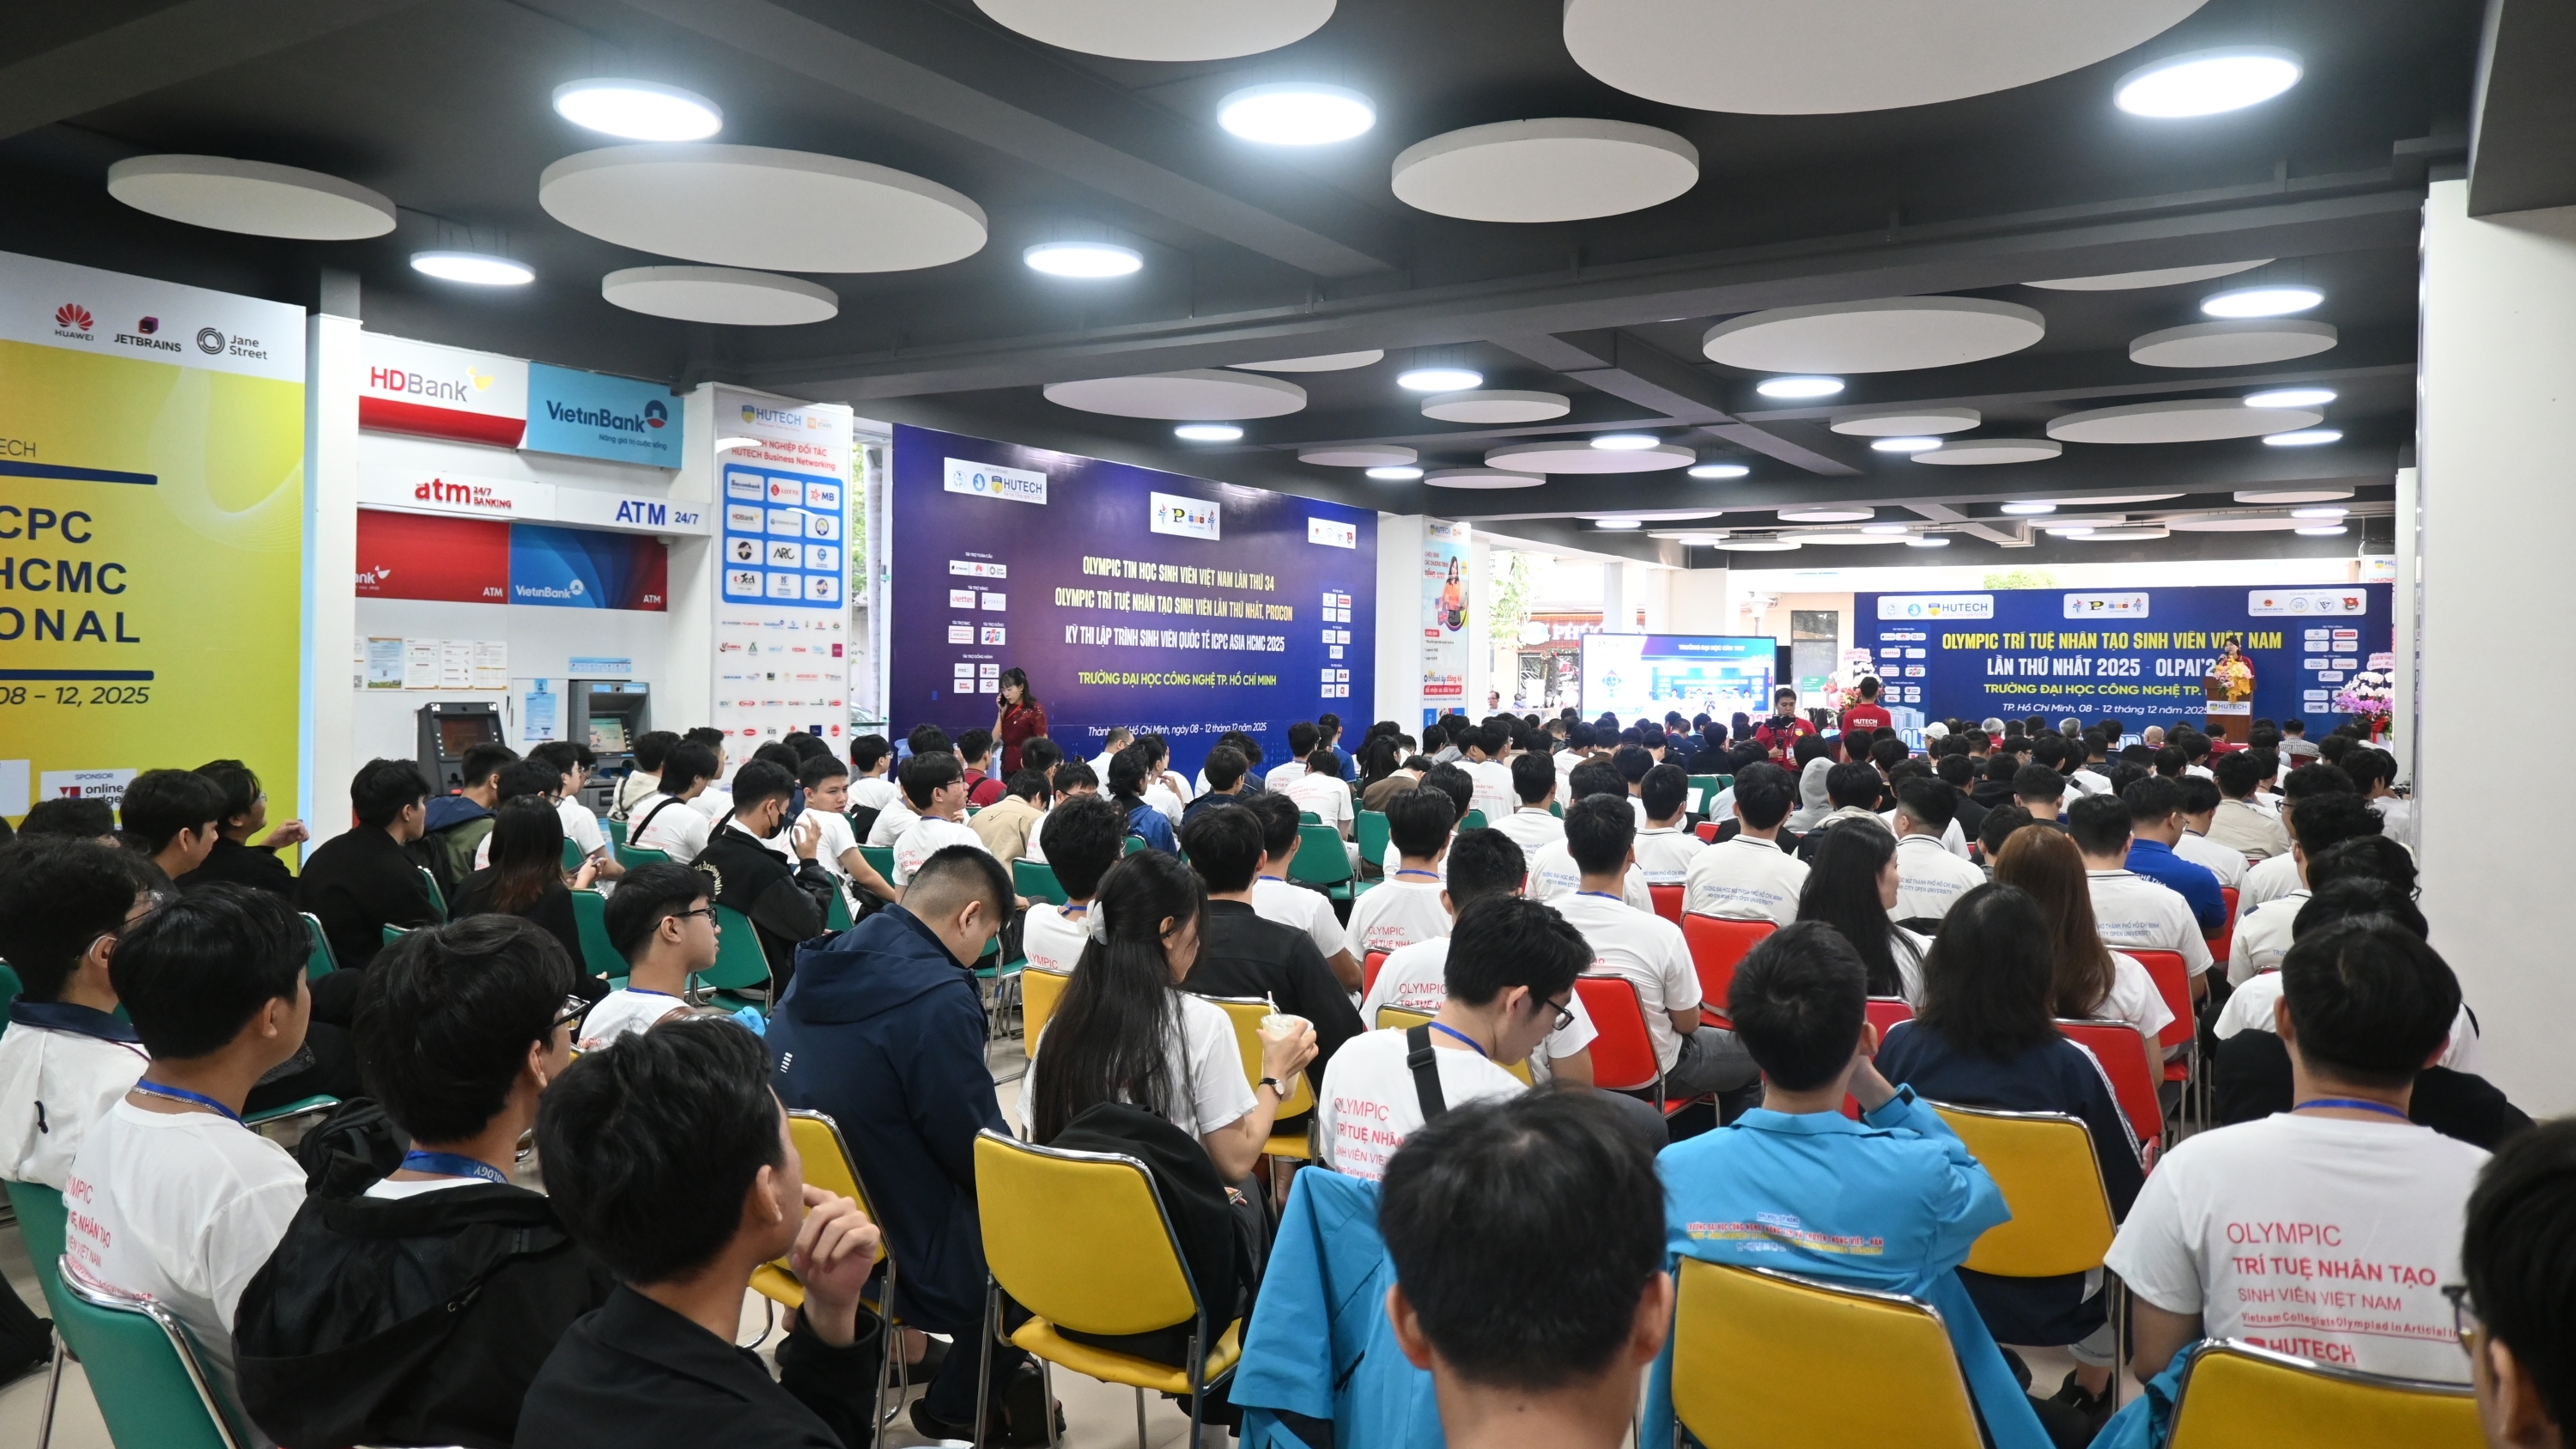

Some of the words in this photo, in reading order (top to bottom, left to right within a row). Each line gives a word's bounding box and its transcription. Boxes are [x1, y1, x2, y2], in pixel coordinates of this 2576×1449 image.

[55, 330, 94, 341] HUAWEI
[114, 333, 181, 352] JETBRAINS
[230, 335, 259, 347] Jane
[229, 346, 268, 360] Street
[371, 367, 467, 402] HDBank
[756, 408, 801, 425] HUTECH
[769, 441, 795, 454] NGHIỆP
[799, 445, 811, 454] ĐỐI
[814, 447, 827, 457] TÁC
[732, 448, 762, 459] HUTECH
[764, 452, 794, 464] Business
[797, 457, 835, 471] Networking
[415, 478, 471, 505] atm
[473, 486, 491, 496] 24/7
[1004, 478, 1042, 494] HUTECH
[473, 496, 512, 508] BANKING
[822, 491, 834, 501] MB
[616, 501, 665, 526] ATM
[675, 512, 699, 524] 24/7
[1435, 526, 1450, 534] HUTECH
[1083, 556, 1121, 577] OLYMPIC
[1123, 560, 1137, 579] TIN
[1139, 562, 1157, 582] HỌC
[1159, 564, 1178, 582] SINH
[1180, 565, 1197, 584] VIÊN
[1200, 568, 1215, 588] VIỆT
[1218, 570, 1233, 588] NAM
[1235, 569, 1247, 589] LẦN
[1249, 573, 1263, 591] THỨ
[1265, 575, 1274, 591] 34
[483, 588, 503, 597] ATM
[643, 594, 661, 604] ATM
[1055, 588, 1095, 608] OLYMPIC
[1097, 589, 1112, 609] TRÍ
[1114, 591, 1130, 612] TUỆ
[1133, 593, 1155, 612] NHÂN
[1157, 595, 1172, 615] TẠO
[1175, 597, 1194, 615] SINH
[1195, 598, 1212, 616] VIÊN
[1214, 597, 1227, 617] LẦN
[1266, 605, 1292, 621] PROCON
[1942, 603, 1988, 612] HUTECH
[1066, 624, 1078, 643] KỲ
[1080, 626, 1094, 644] THI
[1096, 625, 1112, 647] LẬP
[1114, 626, 1138, 646] TRÌNH
[1140, 629, 1158, 647] SINH
[1161, 629, 1177, 648] VIÊN
[1179, 629, 1200, 649] QUỐC
[1201, 630, 1210, 649] TẾ
[1212, 633, 1228, 650] ICPC
[1230, 634, 1245, 650] ASIA
[1247, 635, 1266, 651] HCMC
[1267, 636, 1285, 652] 2025
[1942, 633, 1999, 649] OLYMPIC
[2003, 631, 2026, 648] TRÍ
[2029, 631, 2055, 651] TUỆ
[2059, 631, 2097, 648] NHÂN
[2102, 632, 2129, 651] TẠO
[2133, 632, 2168, 649] SINH
[2173, 630, 2206, 648] VIÊN
[2210, 630, 2243, 648] VIT
[2249, 632, 2282, 648] NAM
[1987, 654, 2014, 675] LẦN
[2019, 656, 2049, 676] THỨ
[2053, 654, 2092, 676] NHẤT
[2097, 658, 2141, 677] 2025
[2155, 658, 2216, 677] OLPAI'2
[1078, 669, 1120, 685] TRƯỜNG
[1121, 673, 1139, 688] ĐẠI
[1140, 673, 1161, 688] HỌC
[1163, 671, 1190, 685] CÔNG
[1192, 672, 1215, 688] NGHỆ
[1217, 674, 1228, 685] TP.
[1230, 671, 1242, 685] HỒ
[1243, 673, 1255, 685] CHÍ
[1258, 675, 1276, 685] MINH
[56, 687, 82, 707] 12,
[90, 687, 150, 703] 2025
[1984, 682, 2037, 694] TRƯỜNG
[2040, 685, 2062, 696] ĐẠI
[2065, 685, 2094, 697] HỌC
[2099, 683, 2140, 695] CÔNG
[2142, 684, 2181, 698] NGHỆ
[2184, 686, 2202, 696] TP.
[2017, 703, 2031, 711] Hồ
[2052, 704, 2076, 713] Minh,
[2114, 705, 2144, 715] tháng
[2159, 705, 2183, 714] năm
[86, 784, 123, 794] online
[1368, 927, 1405, 935] OLYMPIC
[1400, 983, 1448, 995] OLYMPIC
[1334, 1098, 1389, 1121] OLYMPIC
[1337, 1122, 1346, 1136] TRÍ
[1348, 1125, 1368, 1144] TUỆ
[1371, 1130, 1403, 1149] NHÂN
[1335, 1146, 1346, 1155] SINH
[1347, 1148, 1367, 1161] VIÊN
[1346, 1166, 1376, 1179] Collegiate
[2227, 1222, 2342, 1247] OLYMPIC
[2233, 1254, 2266, 1275] TRÍ
[2271, 1257, 2313, 1281] TUỆ
[2318, 1258, 2383, 1283] NHÂN
[2389, 1264, 2436, 1289] TẠO
[2238, 1287, 2275, 1302] SINH
[2279, 1287, 2317, 1306] VIÊN
[2320, 1289, 2357, 1309] VIỆT
[2361, 1294, 2402, 1312] NAM
[2241, 1312, 2281, 1323] Vietnam
[2282, 1312, 2335, 1326] Collegiate
[2336, 1316, 2389, 1331] Olympiad
[2391, 1323, 2401, 1331] in
[2404, 1324, 2446, 1337] Articial
[2268, 1337, 2356, 1363] HUTECH
